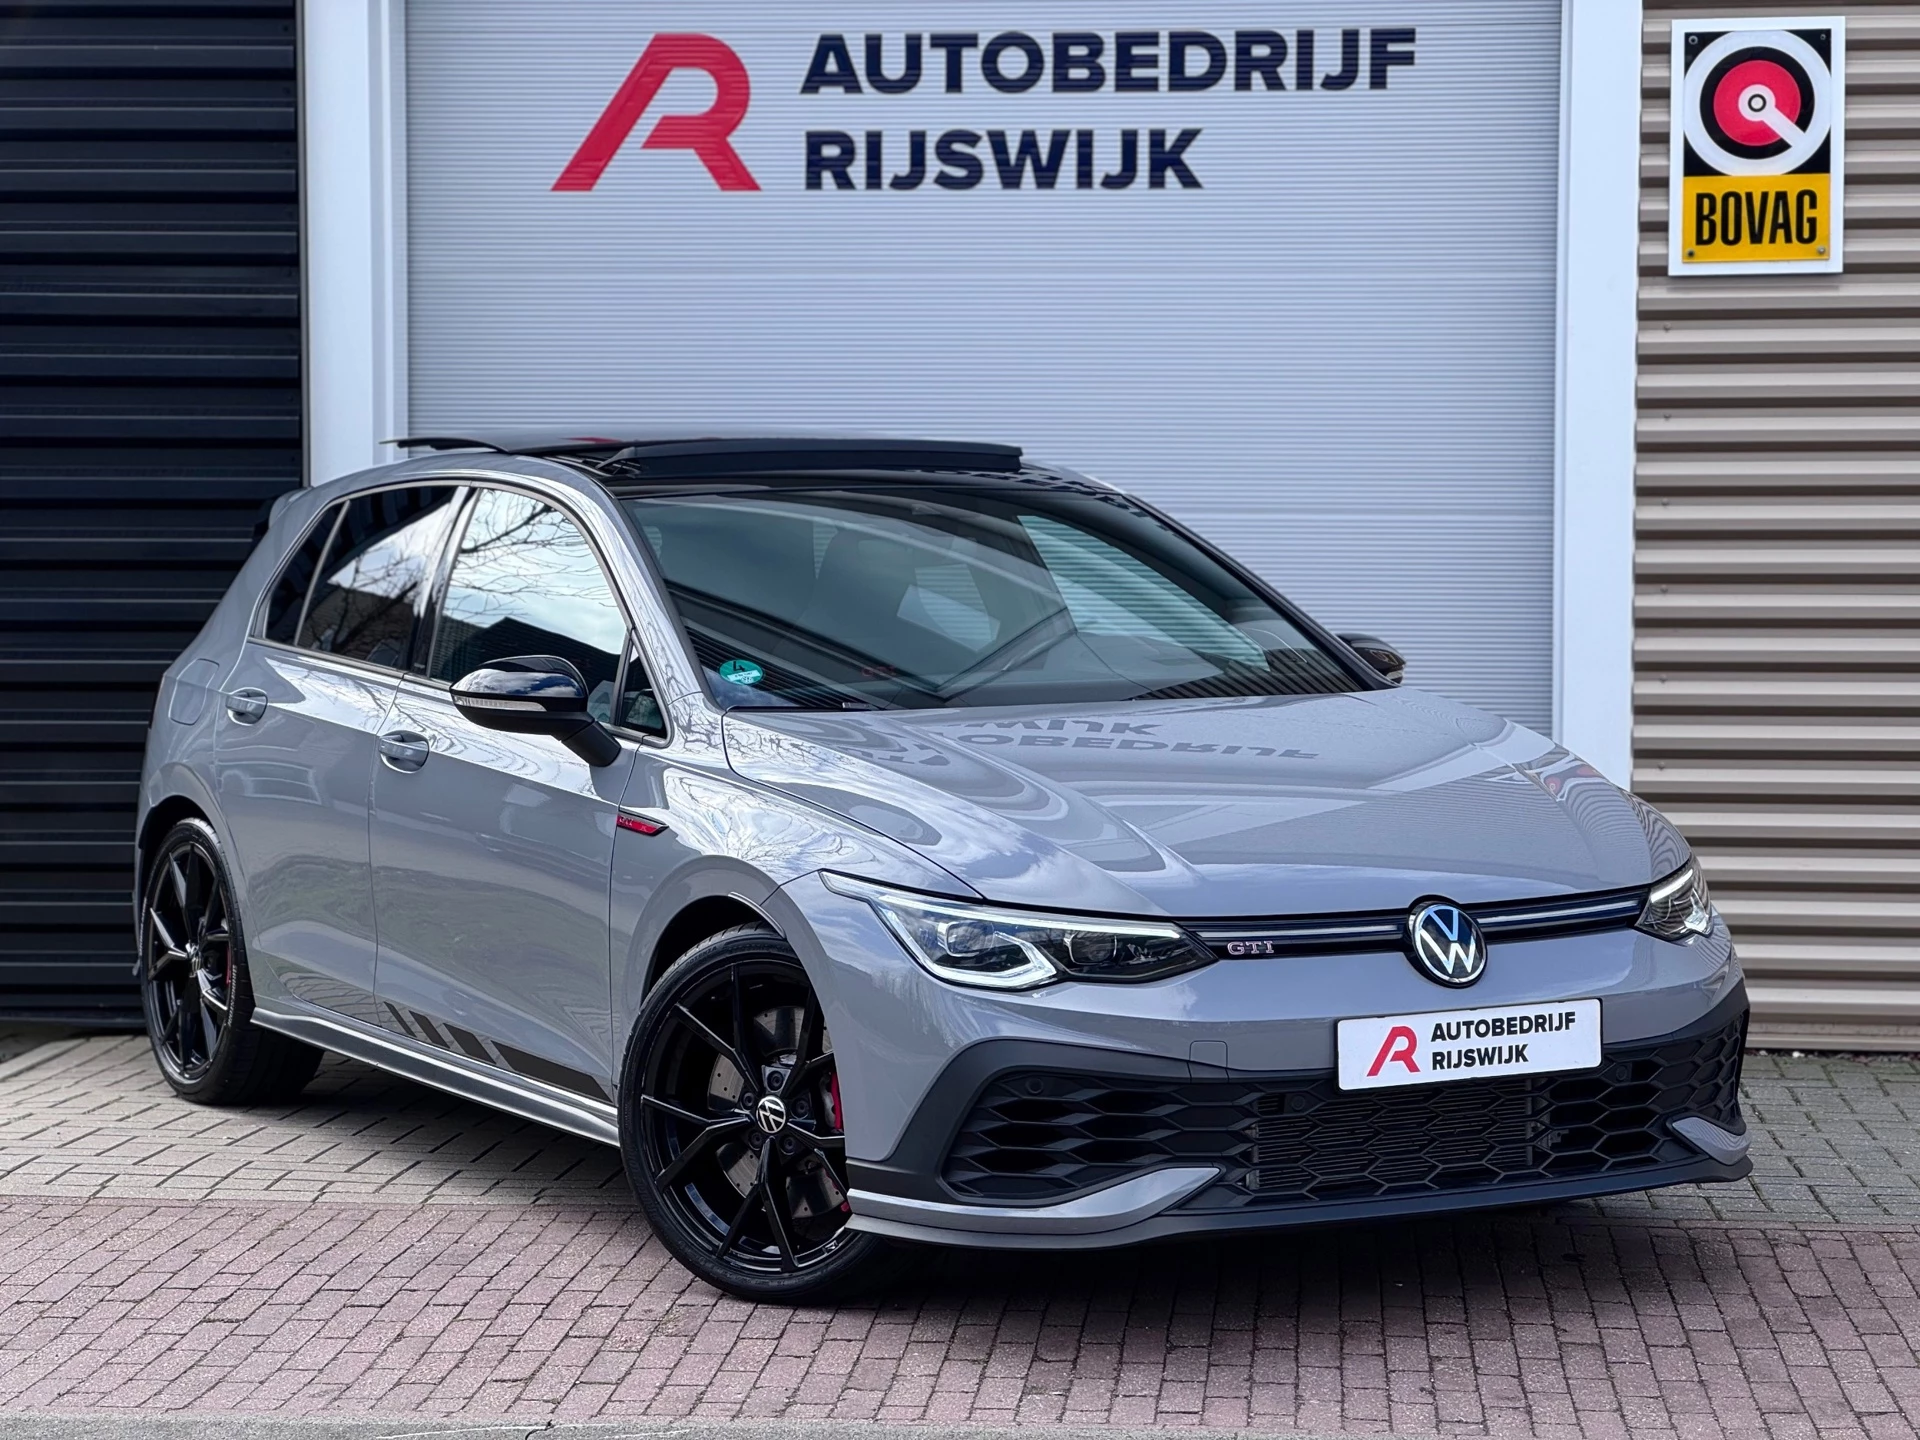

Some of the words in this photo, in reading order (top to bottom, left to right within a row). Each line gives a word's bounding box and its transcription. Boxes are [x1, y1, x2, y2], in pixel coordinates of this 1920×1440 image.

[800, 28, 1416, 94] AUTOBEDRIJF
[805, 129, 1203, 191] RIJSWIJK
[1695, 189, 1818, 246] BOVAG
[1227, 940, 1275, 955] GTI
[1431, 1012, 1575, 1042] AUTOBEDRIJF
[1432, 1044, 1528, 1070] RIJSWIJK
